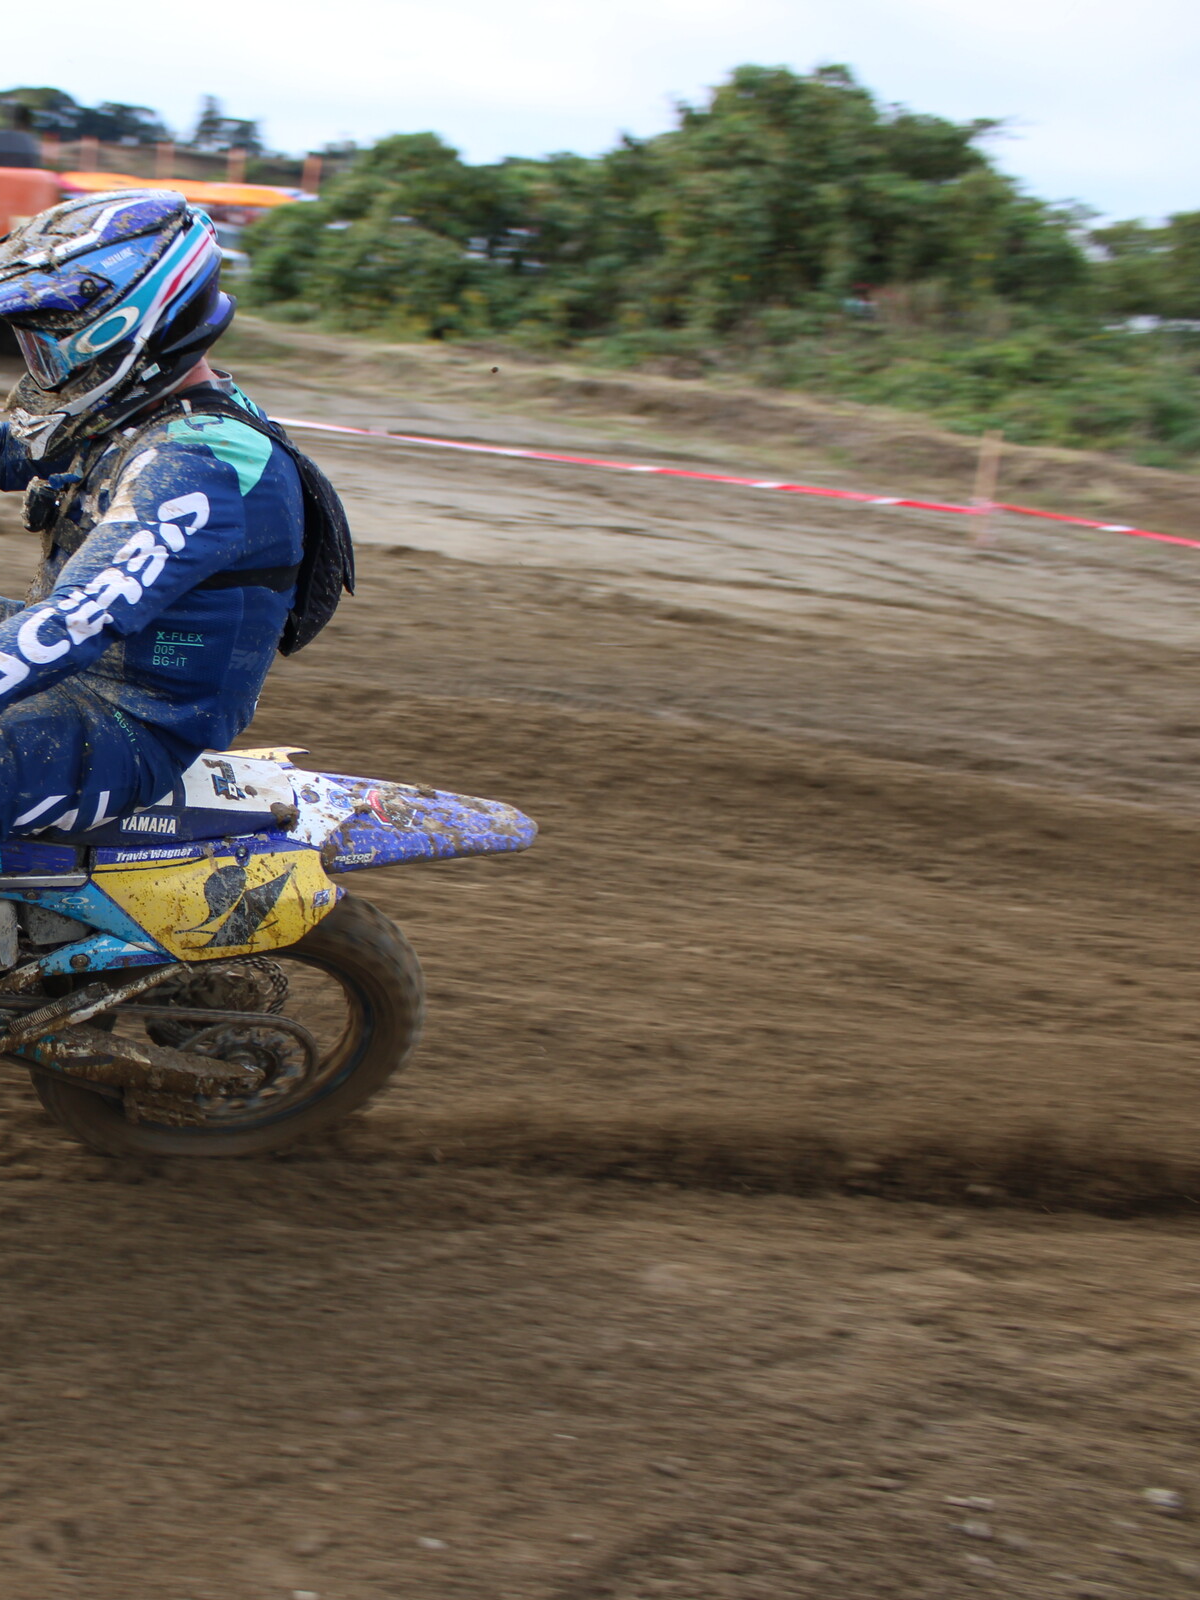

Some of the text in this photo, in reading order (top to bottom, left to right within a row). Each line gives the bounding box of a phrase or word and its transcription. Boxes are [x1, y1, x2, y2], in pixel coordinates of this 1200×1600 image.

[156, 631, 204, 643] X-FLEX
[153, 645, 175, 656] 005
[152, 655, 188, 667] BG-IT
[121, 815, 177, 835] YAMAHA
[116, 847, 194, 862] Travis Wagner
